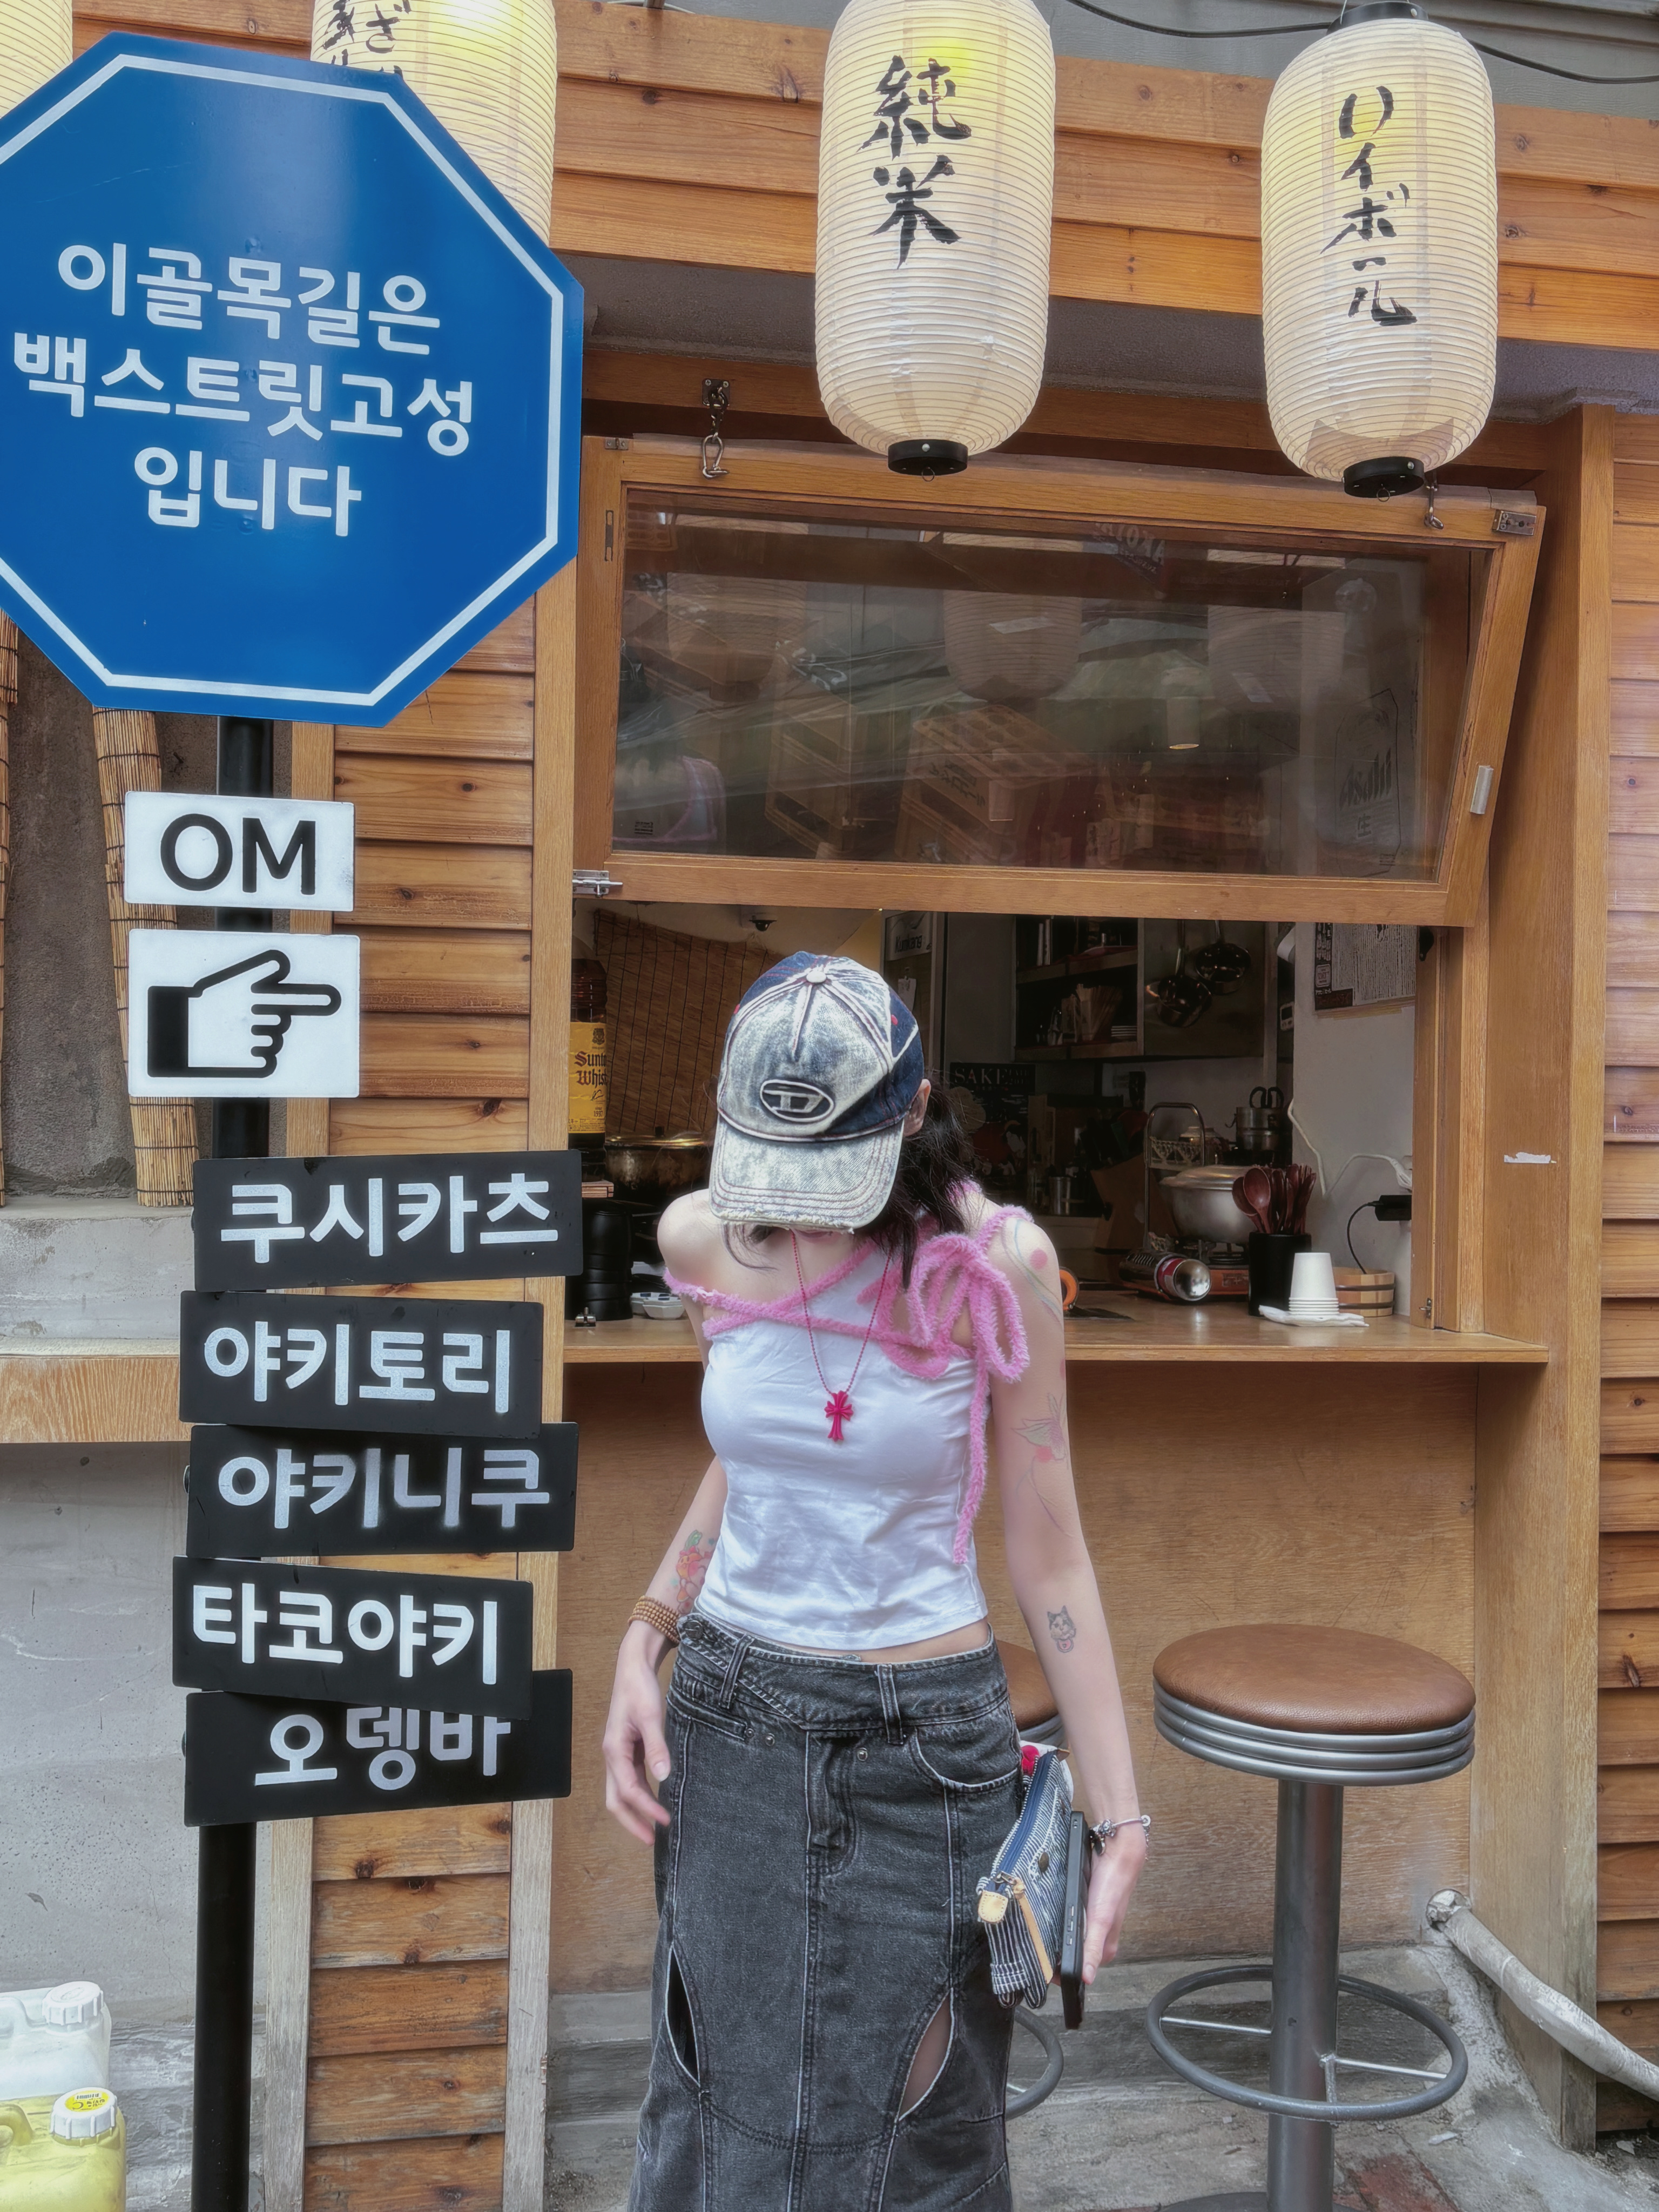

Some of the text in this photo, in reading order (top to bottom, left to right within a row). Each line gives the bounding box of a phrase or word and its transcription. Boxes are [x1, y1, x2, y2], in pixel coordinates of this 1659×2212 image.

[856, 55, 972, 269] 純米
[58, 242, 440, 355] 이골목길은
[14, 332, 473, 457] 백스트릿고성
[134, 446, 362, 536] 입니다
[954, 1067, 1008, 1085] SAKE
[220, 1173, 558, 1264] 쿠시카츠
[204, 1320, 510, 1413] 야키토리
[218, 1447, 550, 1529] 야키니쿠
[193, 1582, 497, 1685] 타코야키
[254, 1705, 511, 1791] 오뎅바
